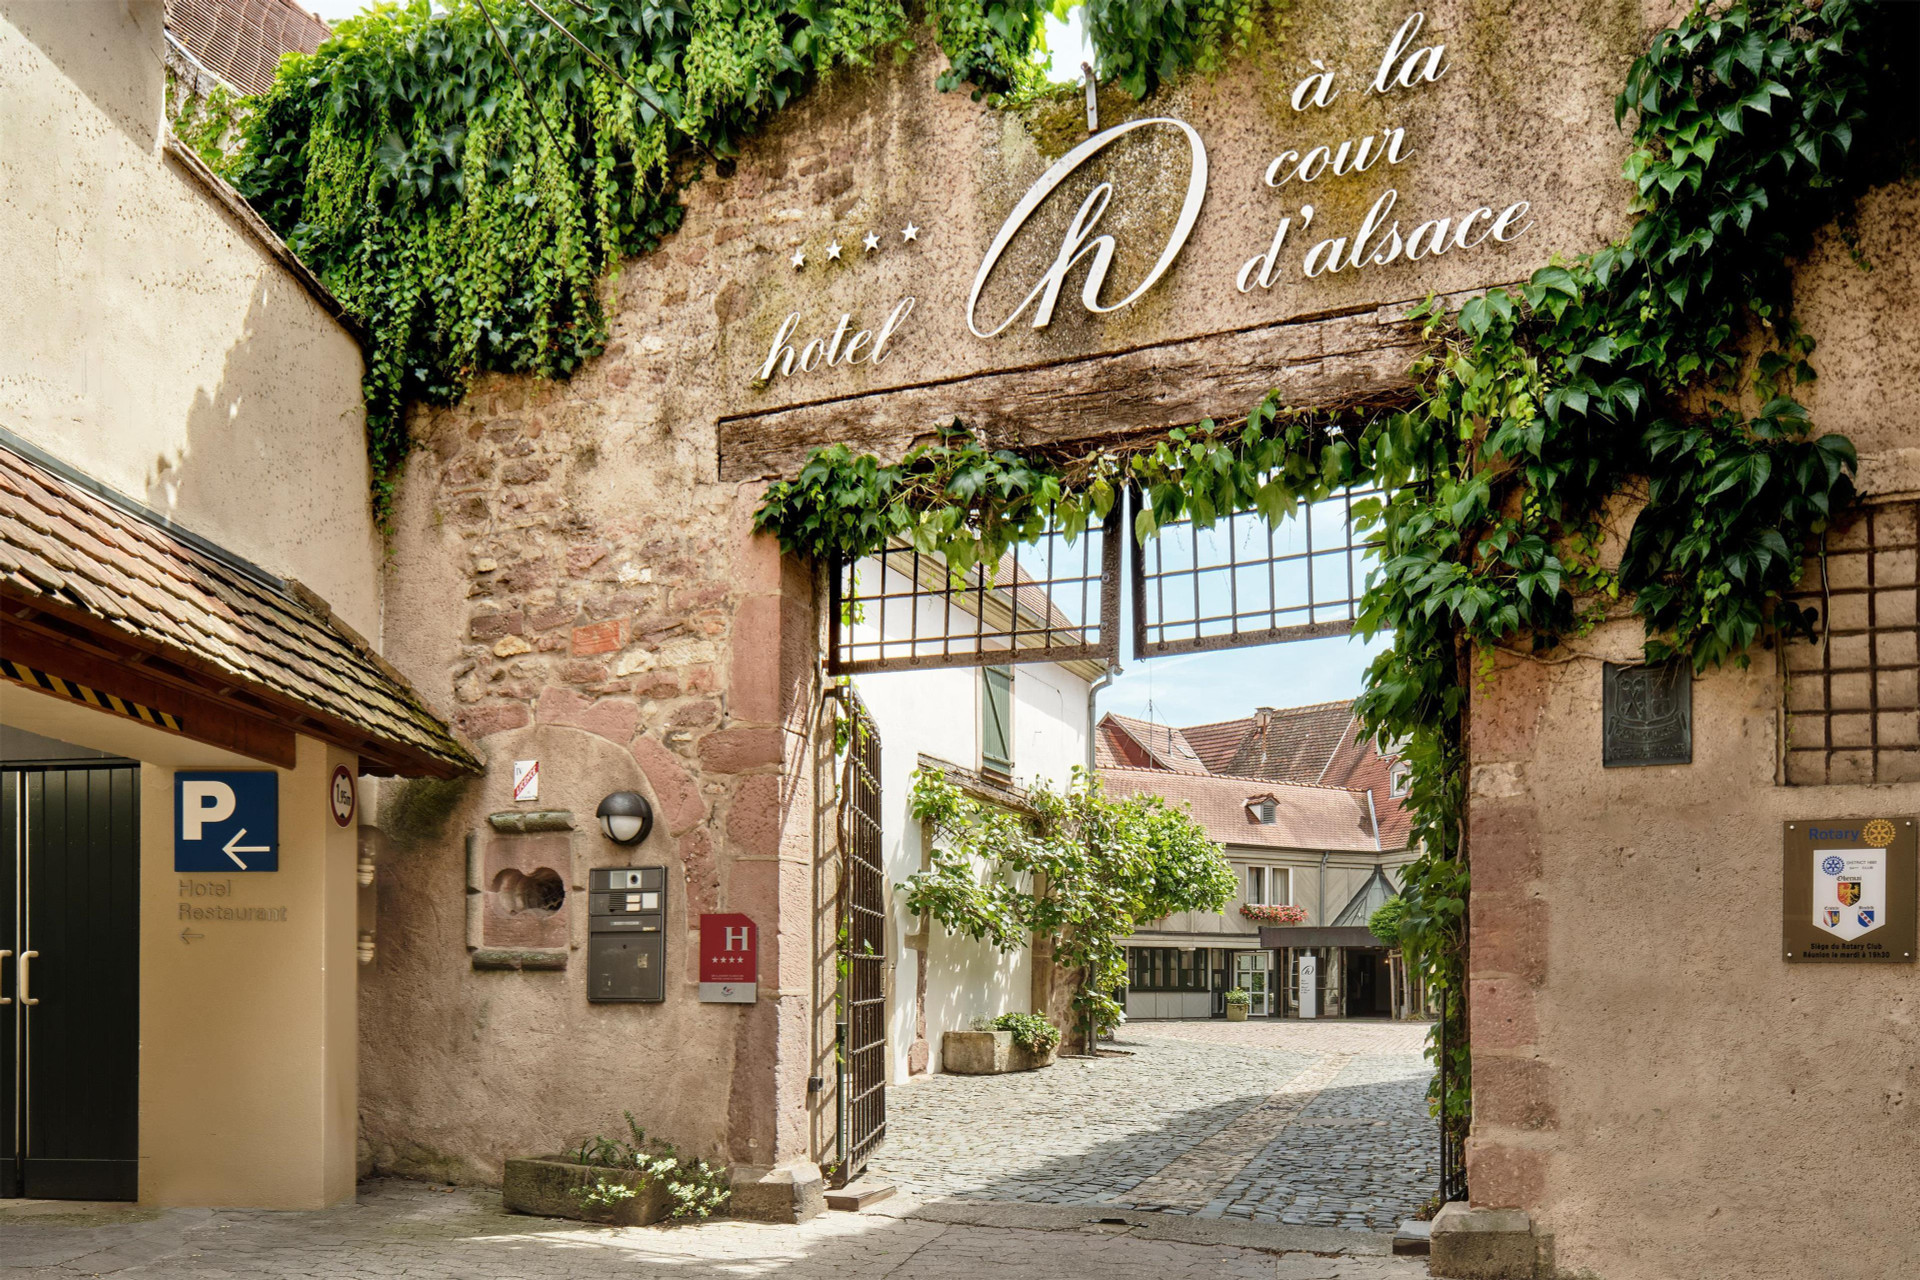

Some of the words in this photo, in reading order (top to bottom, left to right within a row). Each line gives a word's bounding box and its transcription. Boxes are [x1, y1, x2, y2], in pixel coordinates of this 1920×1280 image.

[1291, 59, 1340, 111] à
[1364, 12, 1451, 95] la
[1264, 127, 1415, 187] cour
[1236, 189, 1534, 293] d'alsace
[750, 297, 915, 380] hotel
[183, 780, 236, 840] P
[1808, 827, 1860, 842] Rotary
[178, 879, 232, 897] Hotel
[178, 902, 288, 922] Restaurant
[724, 926, 750, 951] H
[1831, 942, 1840, 950] du
[1841, 942, 1865, 951] Rotary
[1866, 942, 1883, 950] Club
